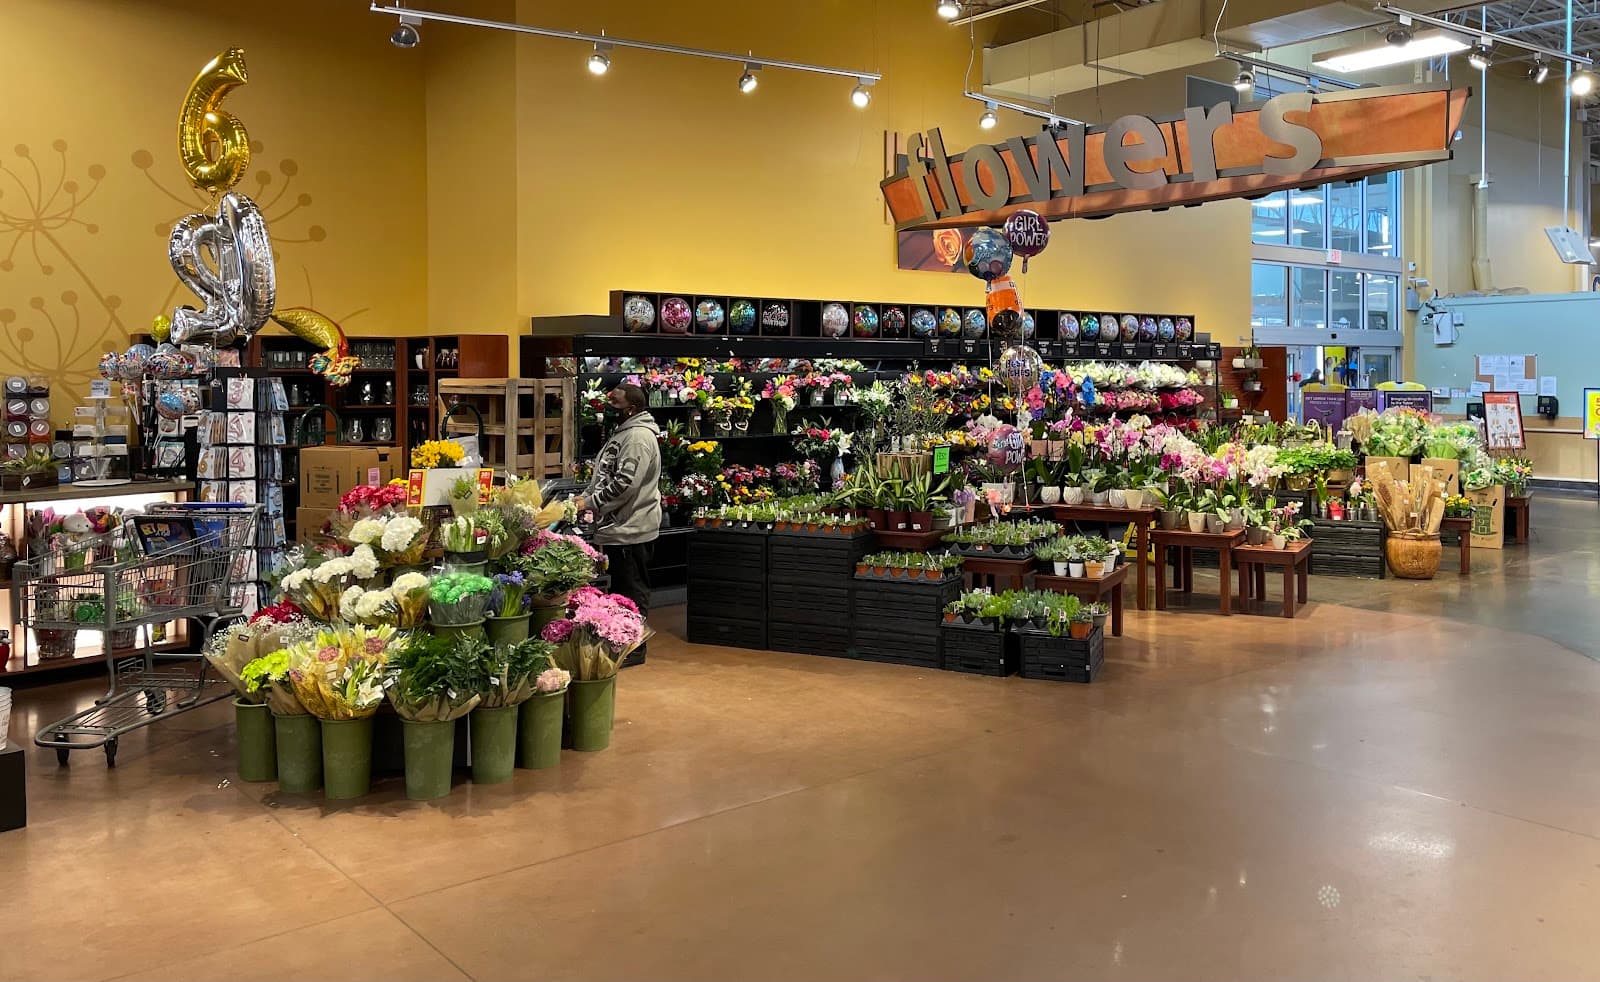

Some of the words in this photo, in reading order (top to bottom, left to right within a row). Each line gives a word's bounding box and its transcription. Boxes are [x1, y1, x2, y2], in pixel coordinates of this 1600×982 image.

[906, 92, 1323, 222] flowers
[1015, 215, 1044, 232] GIRL
[1010, 231, 1048, 247] POWER
[1009, 432, 1025, 449] GIR
[230, 450, 246, 472] 4
